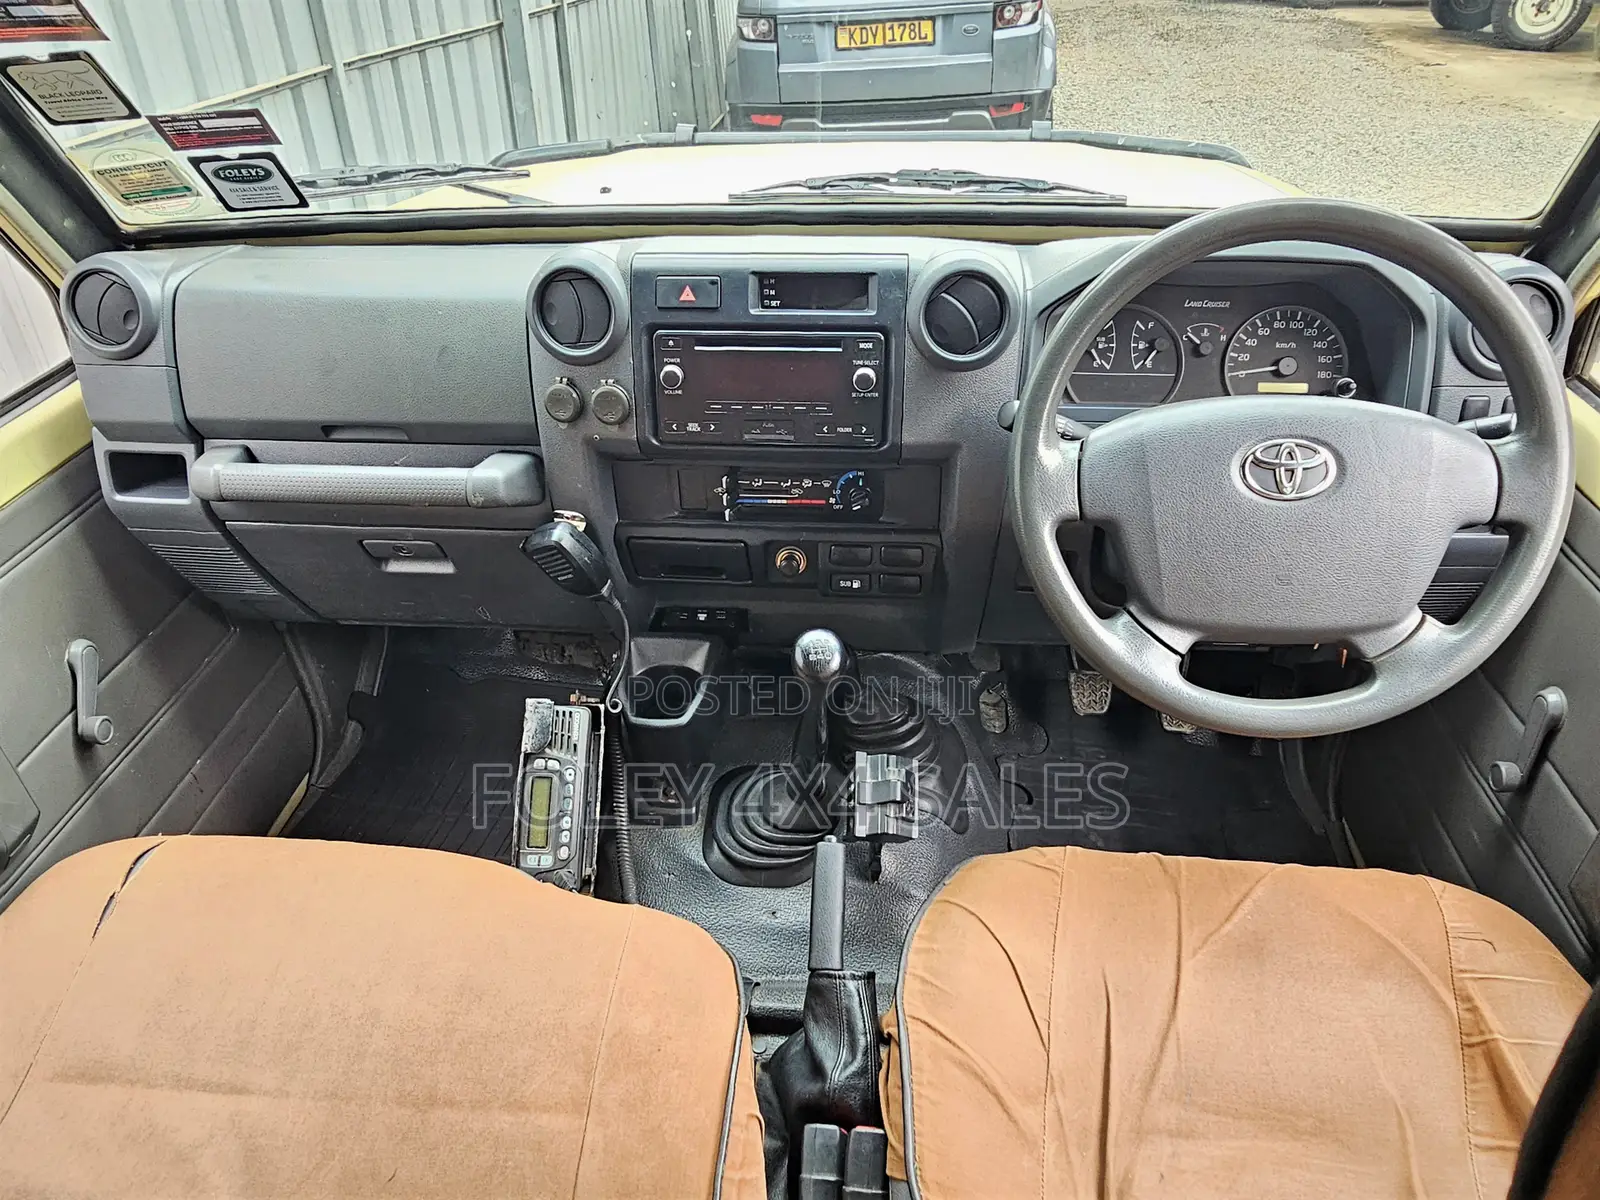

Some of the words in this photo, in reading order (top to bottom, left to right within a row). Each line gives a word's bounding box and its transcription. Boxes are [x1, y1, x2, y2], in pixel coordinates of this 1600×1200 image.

[848, 26, 879, 46] KDY
[887, 21, 928, 42] 178L
[65, 89, 103, 97] LEOPARD
[218, 167, 265, 178] FOLEYS
[1148, 321, 1155, 329] F
[1273, 321, 1286, 329] 80
[1289, 321, 1304, 329] 100
[1257, 327, 1270, 336] 60
[1303, 328, 1318, 337] 120
[1220, 334, 1227, 342] H
[1245, 338, 1258, 347] 40
[1275, 341, 1297, 349] km/h
[1313, 340, 1328, 349] 140
[1238, 353, 1250, 361] 20
[1317, 355, 1333, 364] 160
[1317, 370, 1332, 379] 180
